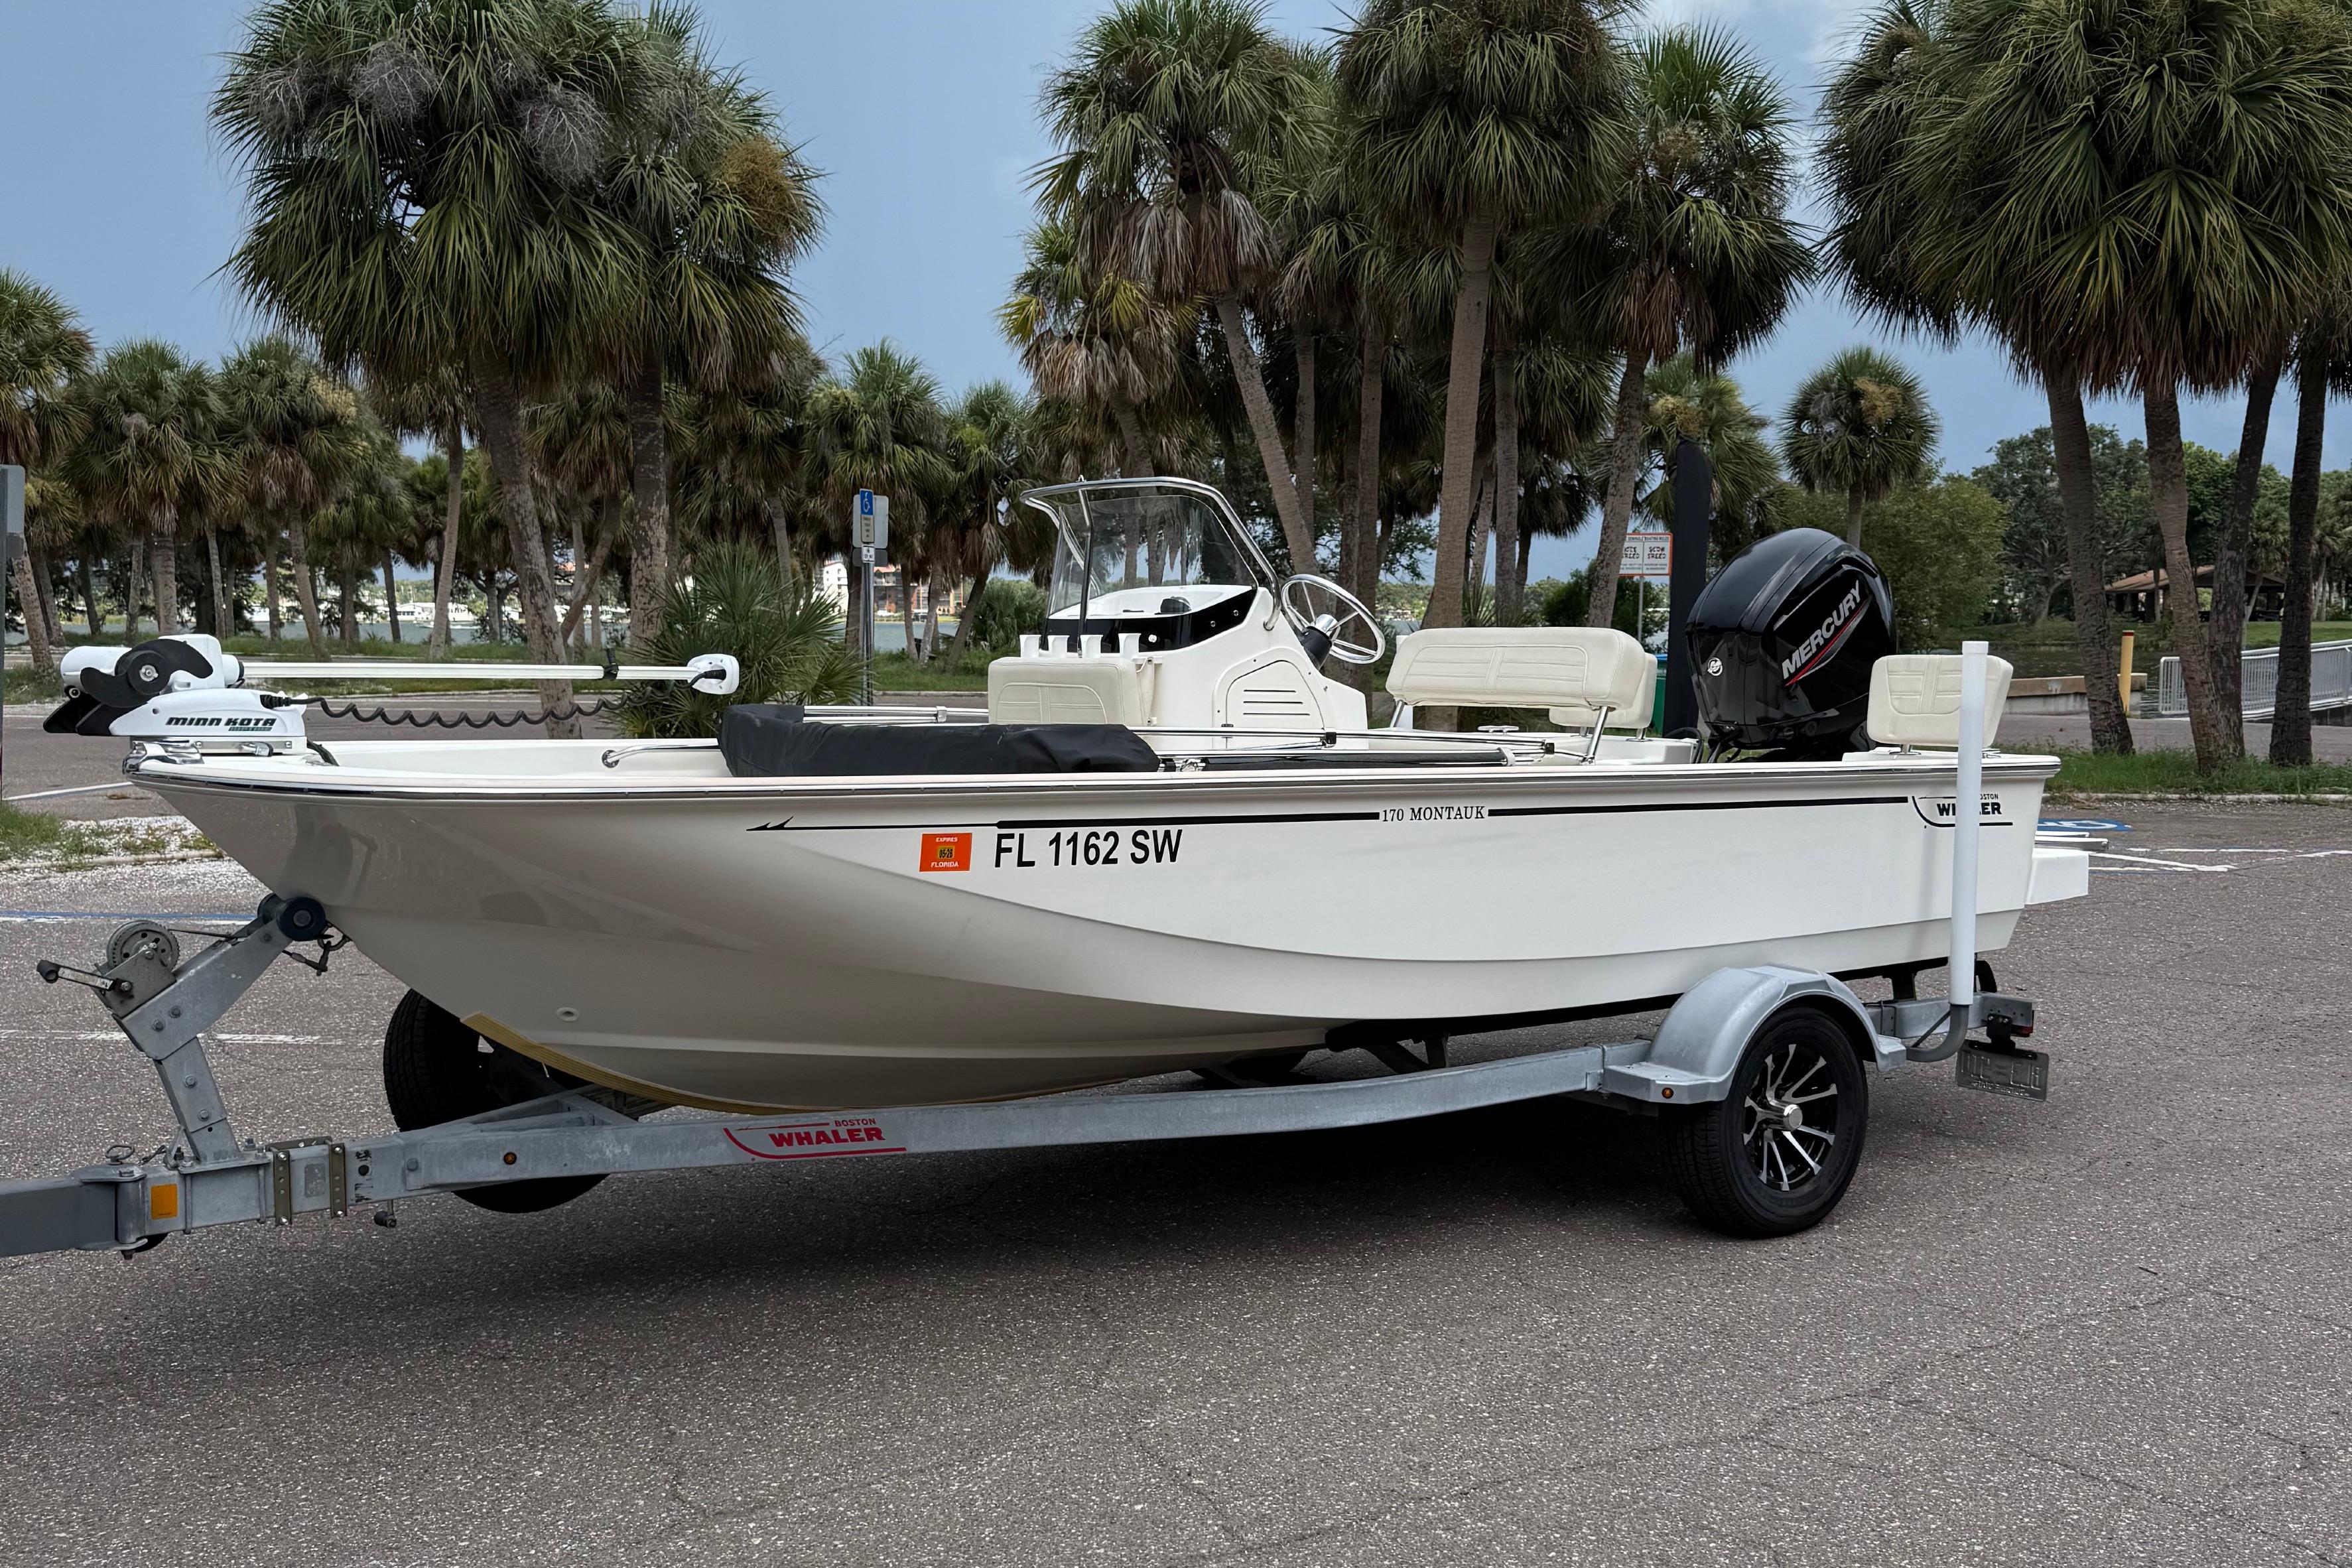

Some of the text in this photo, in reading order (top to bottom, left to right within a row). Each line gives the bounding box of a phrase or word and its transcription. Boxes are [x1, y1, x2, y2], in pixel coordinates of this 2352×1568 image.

[1782, 579, 1861, 680] MERCURY
[224, 718, 277, 726] KOTA
[1382, 806, 1485, 822] 170 MONTAUK
[995, 829, 1183, 868] FL 1162 SW
[834, 1118, 876, 1127] BOSTON
[768, 1127, 885, 1147] WHALER
